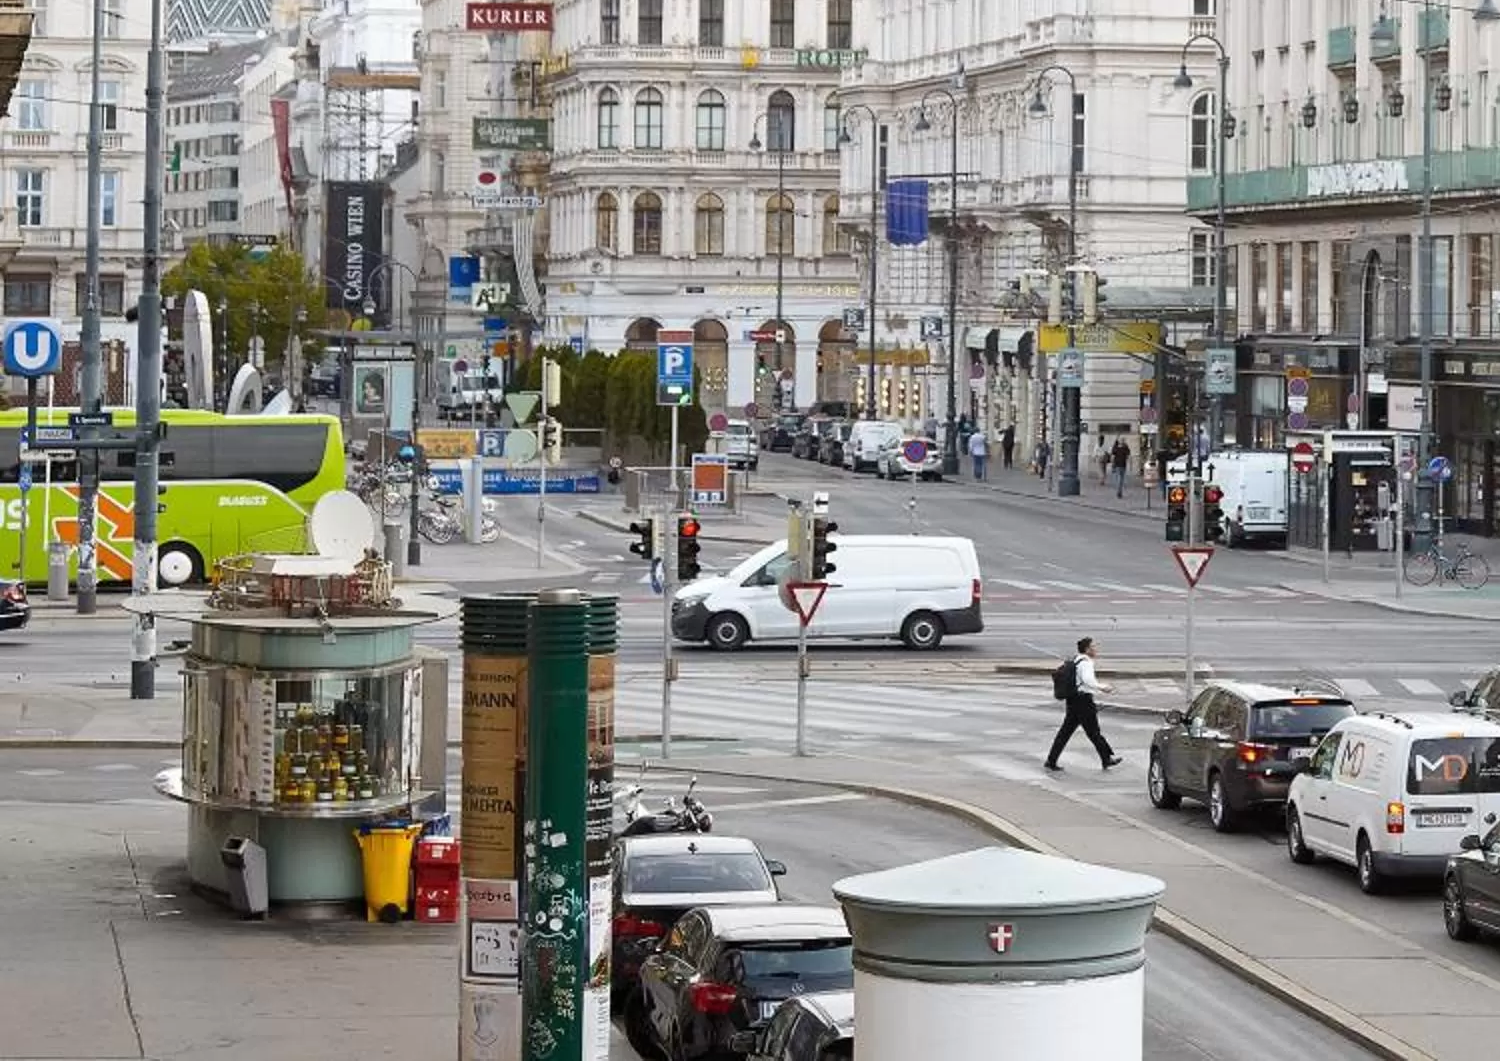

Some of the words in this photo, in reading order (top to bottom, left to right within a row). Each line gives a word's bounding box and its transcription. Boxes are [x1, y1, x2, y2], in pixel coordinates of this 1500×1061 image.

[472, 8, 548, 24] KURIER
[347, 196, 364, 236] WIEN
[343, 242, 363, 300] CASINO
[13, 330, 50, 369] U
[664, 352, 684, 376] P
[1415, 753, 1469, 783] MD
